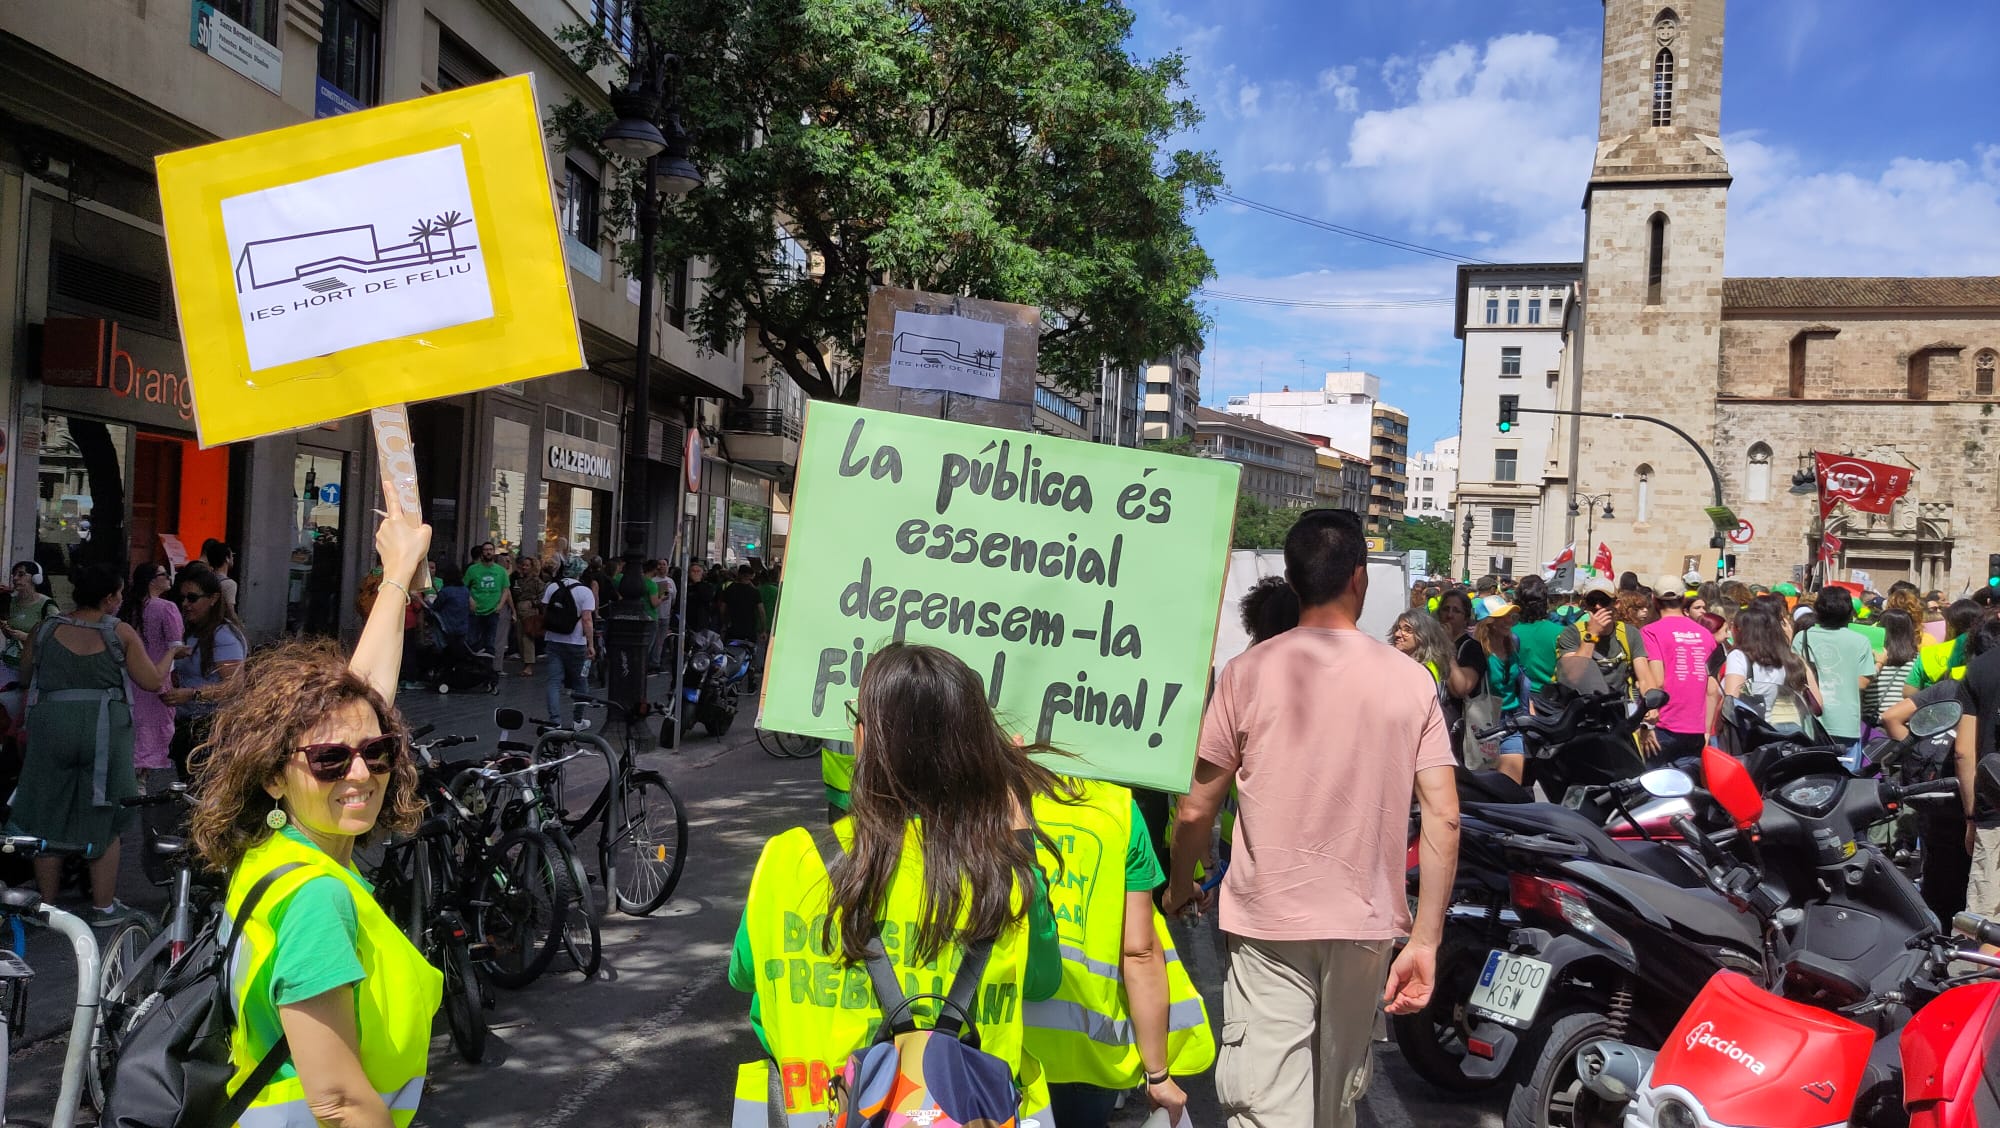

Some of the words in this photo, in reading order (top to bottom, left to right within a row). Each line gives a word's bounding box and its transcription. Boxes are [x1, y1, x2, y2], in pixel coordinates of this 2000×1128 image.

[250, 304, 286, 322] IES
[293, 286, 356, 312] HORT
[364, 278, 397, 294] DE
[406, 262, 472, 286] FELIU
[915, 361, 945, 369] HORT
[966, 368, 996, 378] FELIU
[549, 445, 612, 479] CALZEDONIA
[838, 417, 902, 485] La
[936, 438, 1094, 515] pública
[1116, 467, 1173, 525] és
[895, 518, 1123, 588] essencial
[839, 556, 1143, 660] defensem-la
[1034, 670, 1183, 749] final!
[1486, 981, 1525, 1011] KGW
[1500, 958, 1545, 988] 1900
[1699, 1032, 1767, 1076] acciona
